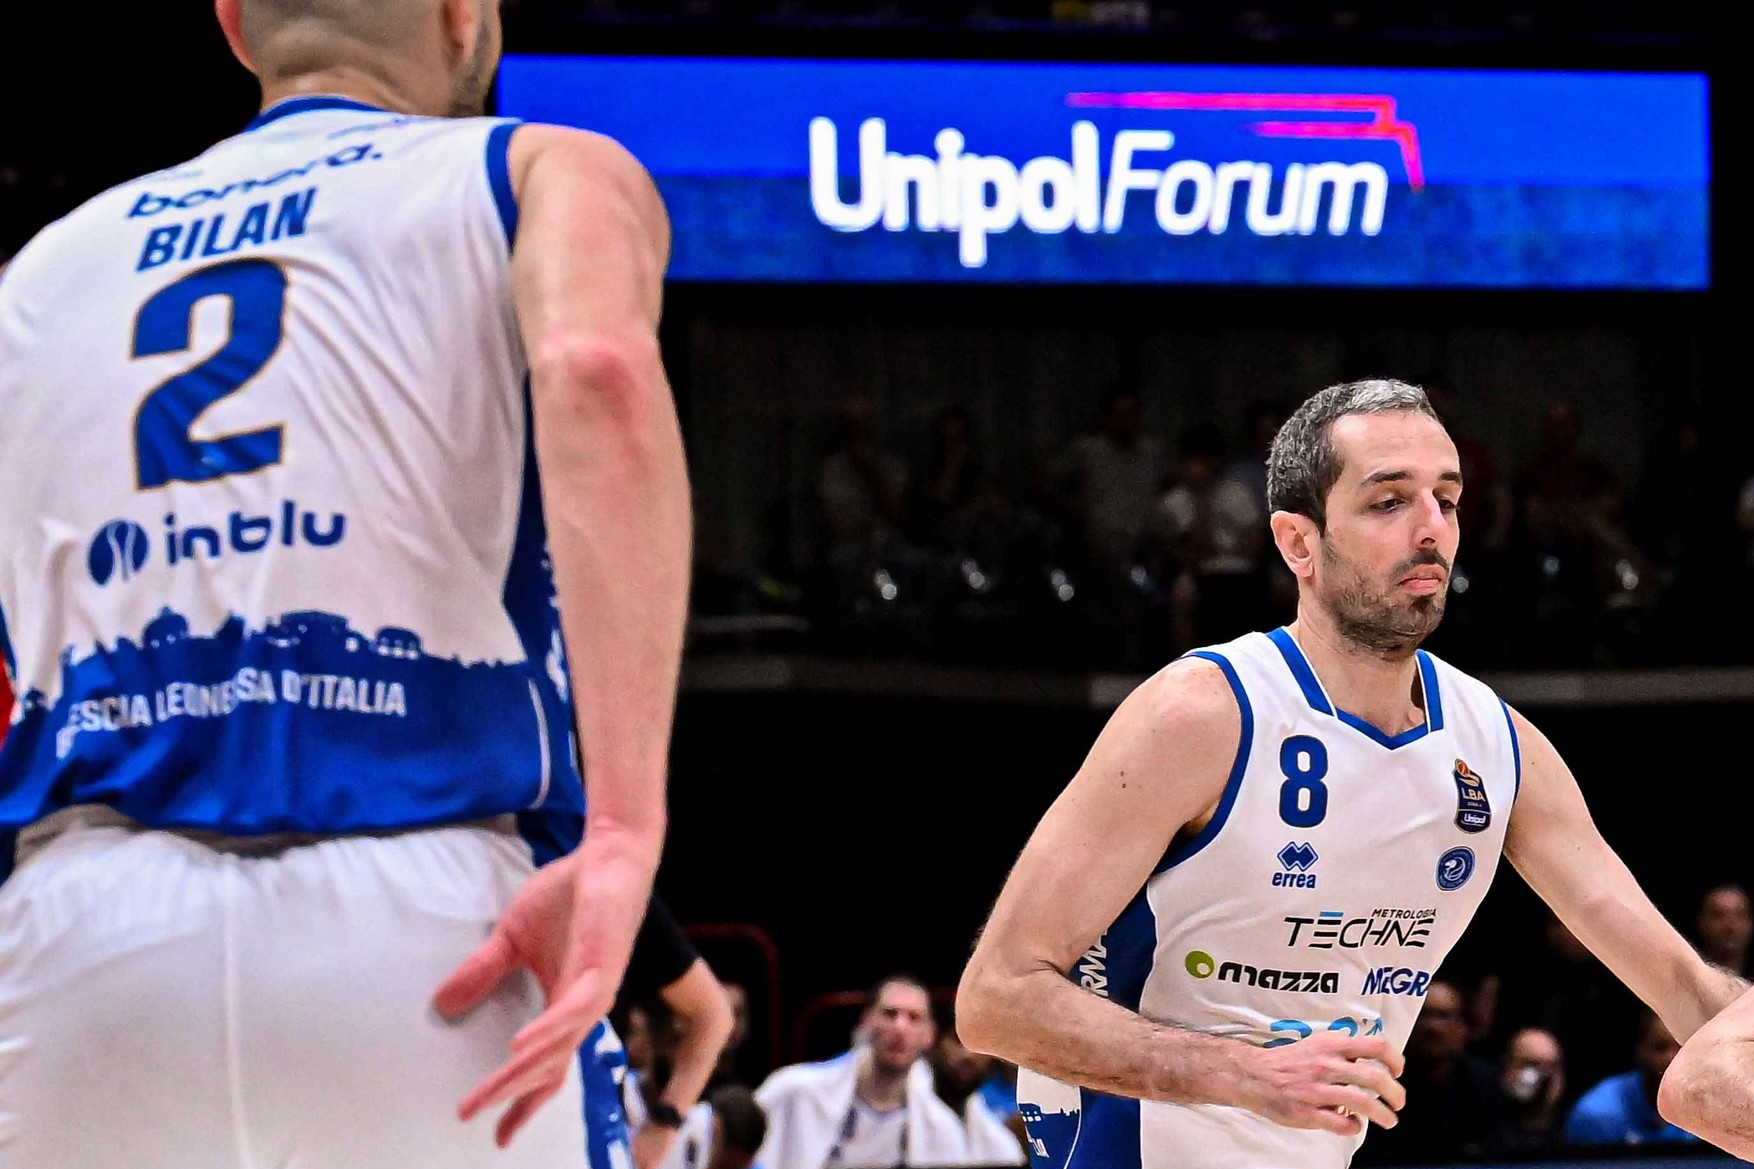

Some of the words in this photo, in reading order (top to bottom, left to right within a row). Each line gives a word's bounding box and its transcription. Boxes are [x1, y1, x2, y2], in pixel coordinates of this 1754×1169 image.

[809, 116, 1388, 268] UnipolForum
[136, 186, 317, 272] BILAN
[131, 256, 288, 491] 2
[164, 500, 345, 565] inblu
[1279, 734, 1328, 828] 8
[1461, 787, 1486, 803] LBA
[1284, 911, 1435, 949] TECHNE
[1371, 908, 1437, 920] METROLOGIA
[1218, 961, 1340, 994] mazza
